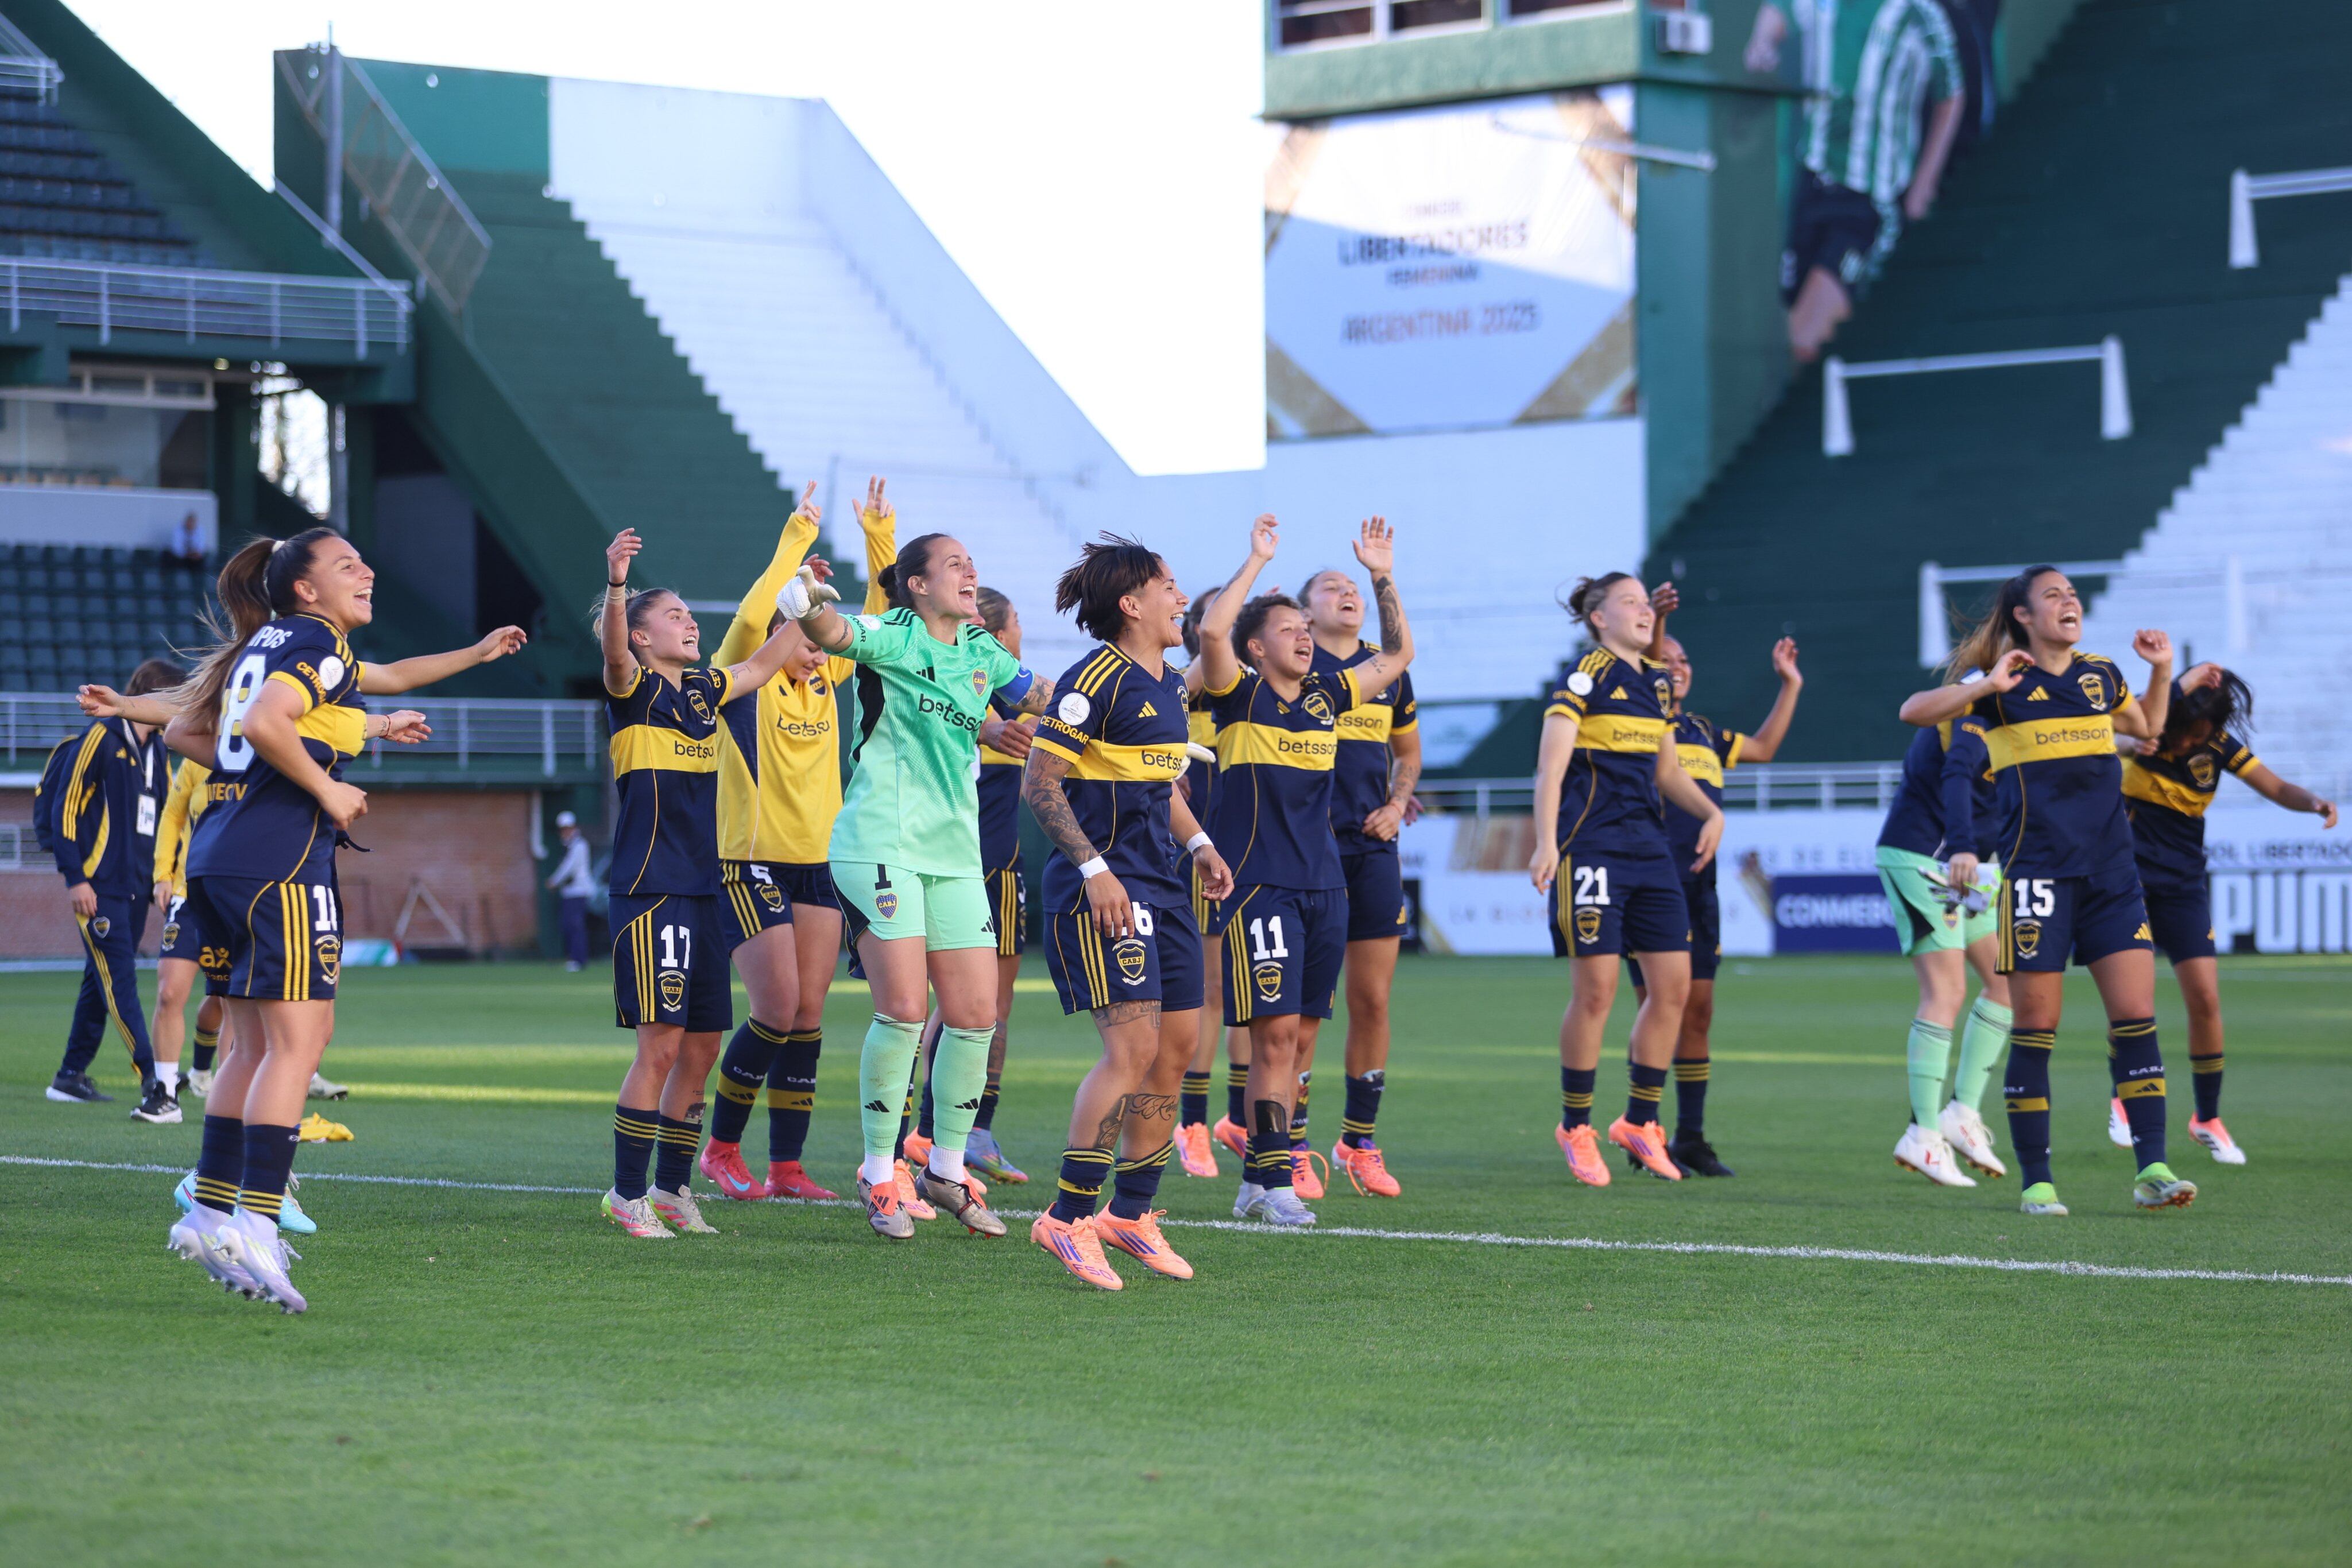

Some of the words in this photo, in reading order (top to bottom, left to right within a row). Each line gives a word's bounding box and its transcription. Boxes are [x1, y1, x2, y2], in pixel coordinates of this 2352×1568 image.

[1040, 715, 1089, 745] CETROGAR
[1336, 716, 1383, 729] tsson
[2035, 727, 2109, 745] betsson
[1574, 866, 1611, 905] 21
[2014, 878, 2055, 917] 15
[878, 900, 896, 909] CABJ
[661, 925, 690, 969] 17
[1250, 916, 1289, 961] 11
[1073, 1263, 1115, 1281] F50
